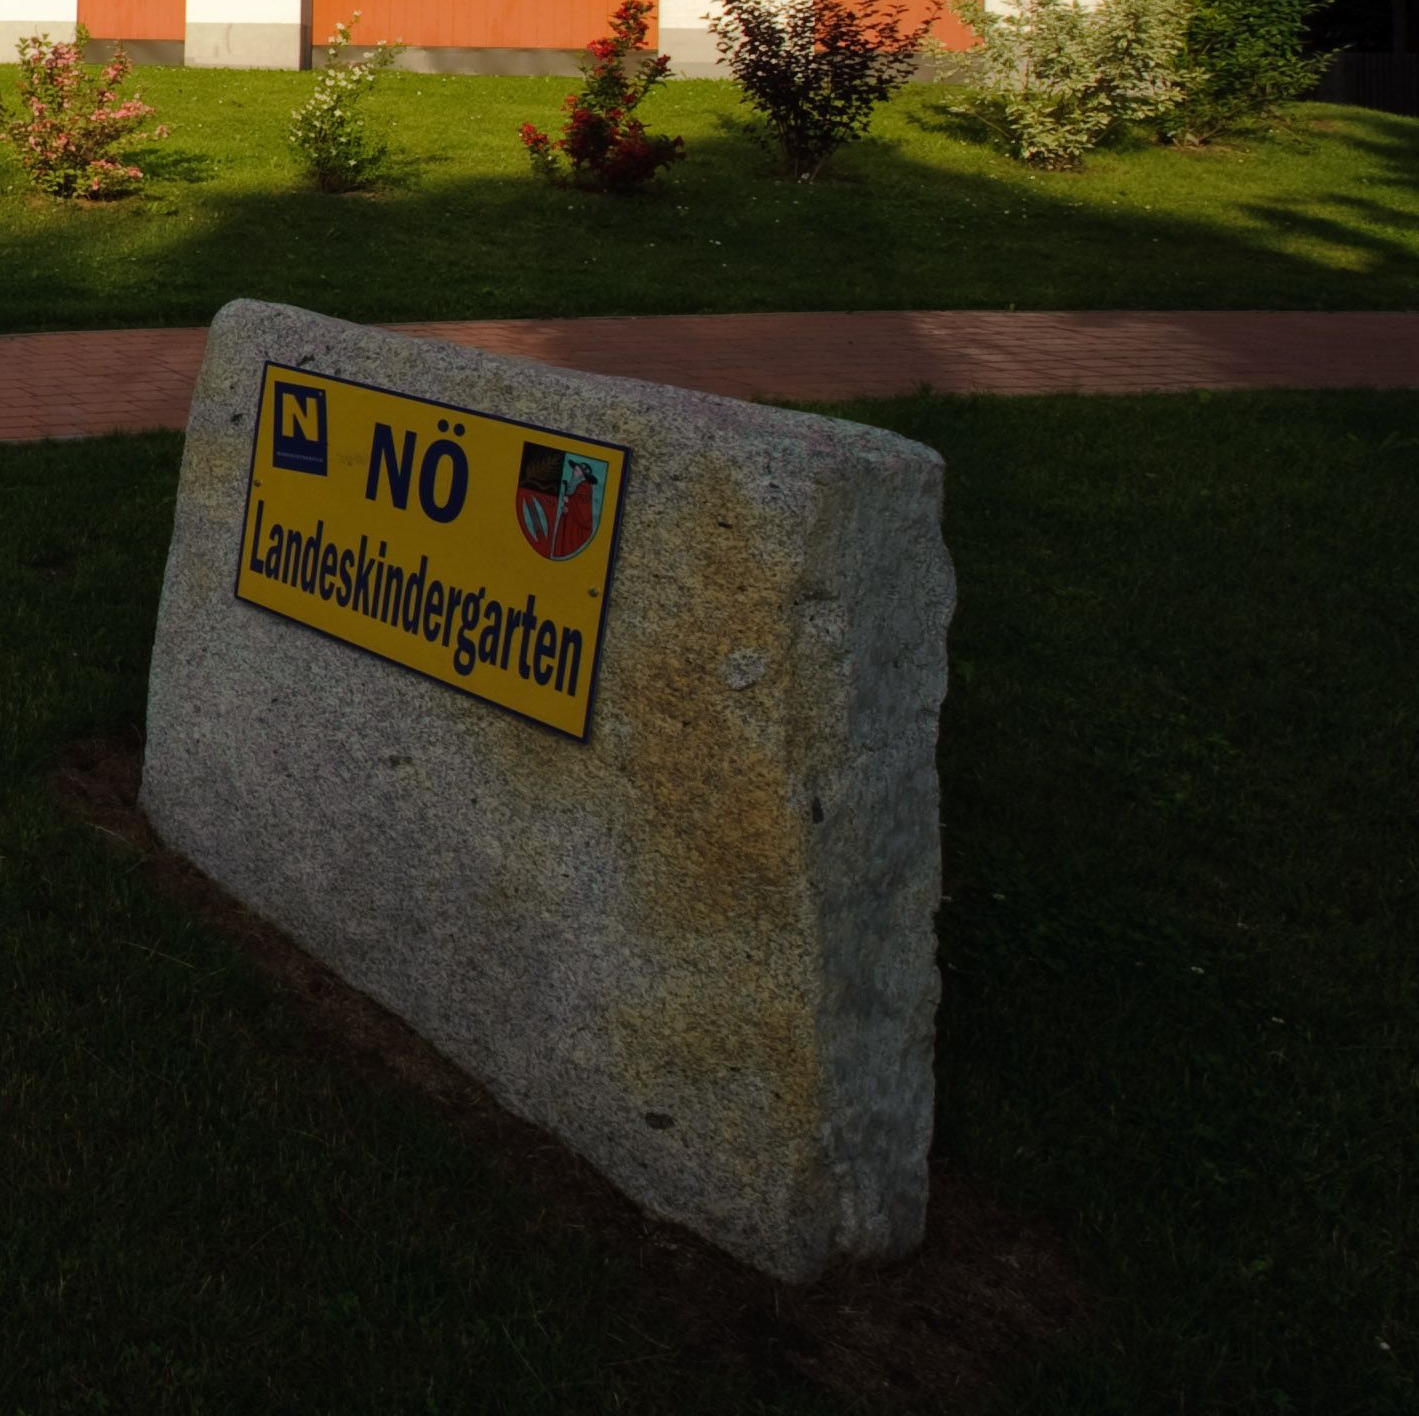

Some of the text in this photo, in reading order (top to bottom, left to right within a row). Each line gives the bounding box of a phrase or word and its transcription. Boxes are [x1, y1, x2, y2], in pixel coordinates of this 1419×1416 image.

[282, 392, 319, 442] N
[365, 419, 469, 524] NÖ
[249, 499, 583, 697] Landeskindergarten
